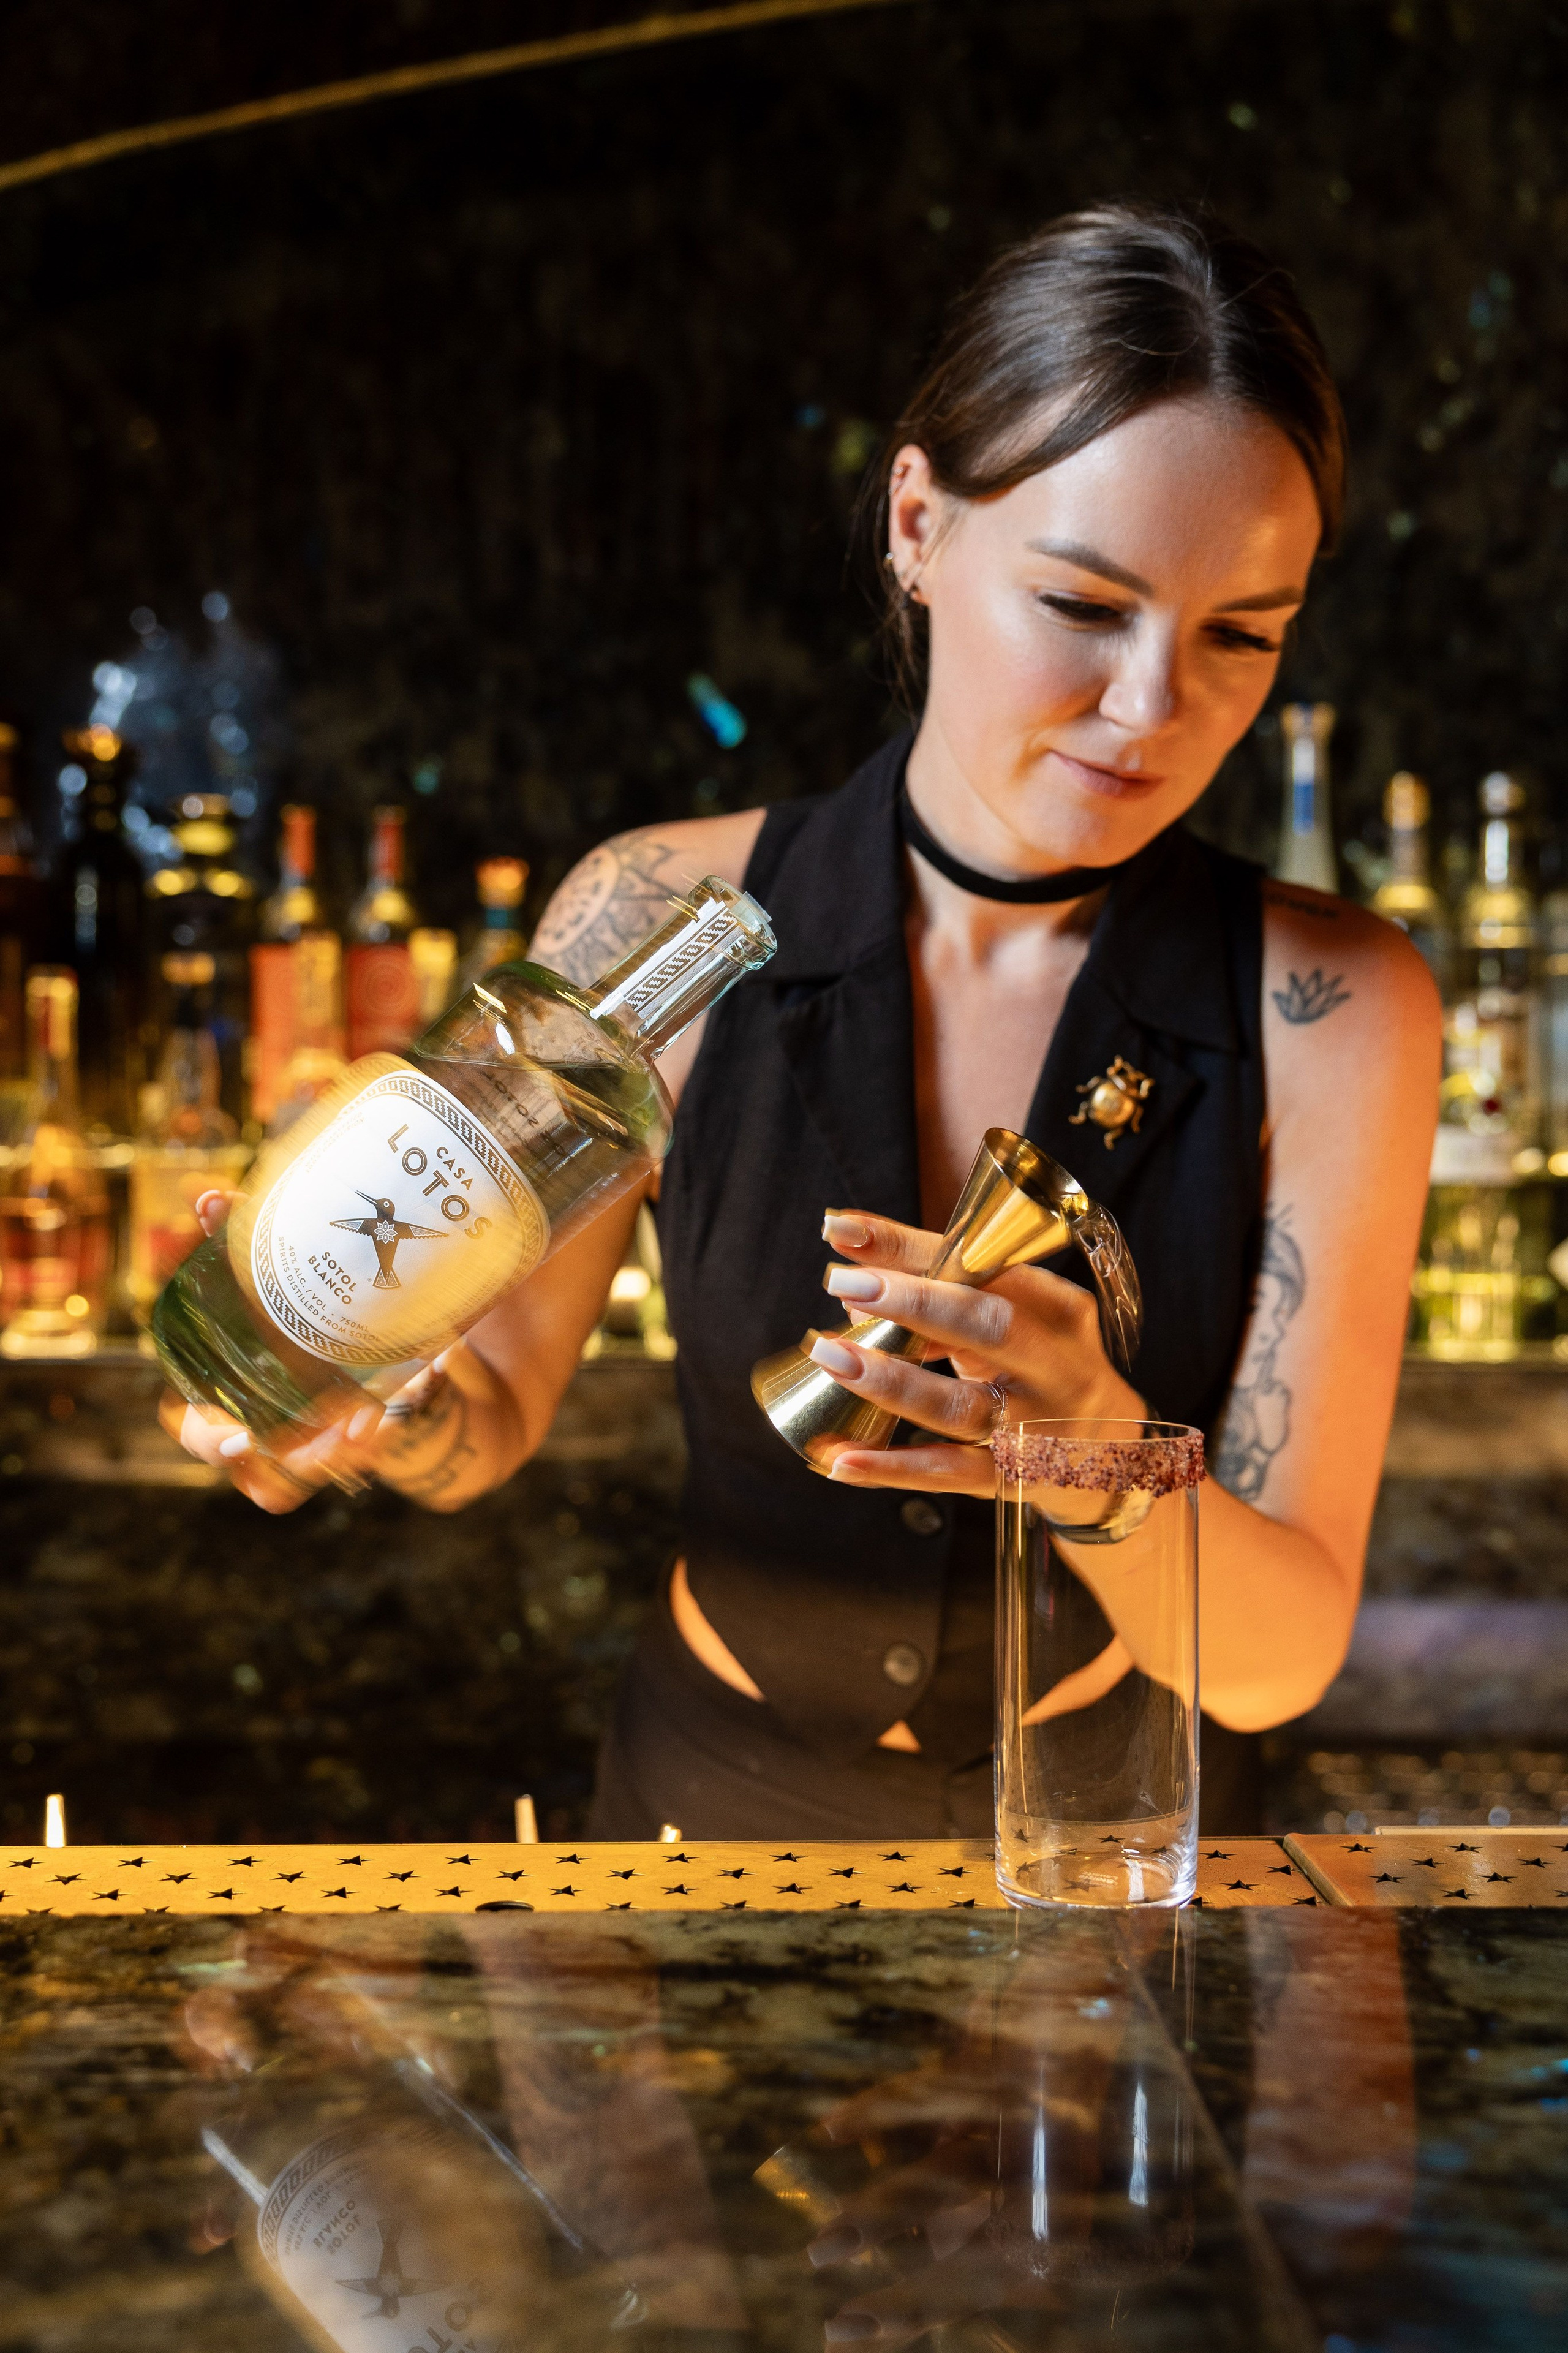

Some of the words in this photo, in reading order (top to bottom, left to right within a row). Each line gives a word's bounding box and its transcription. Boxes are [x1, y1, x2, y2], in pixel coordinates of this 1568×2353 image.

[387, 1124, 493, 1240] LOTOS
[436, 1146, 473, 1190] CASA
[279, 1236, 290, 1272] SPIRITS
[287, 1274, 319, 1316] DISTILLED
[320, 1315, 346, 1334] FROM
[349, 1331, 381, 1342] SOTOL
[289, 1245, 298, 1264] 40%
[294, 1267, 306, 1288] ALC.
[312, 1293, 326, 1311] VOL
[340, 1316, 370, 1332] 750ML
[307, 1255, 352, 1305] BLANCO
[322, 1252, 356, 1292] SOTOL
